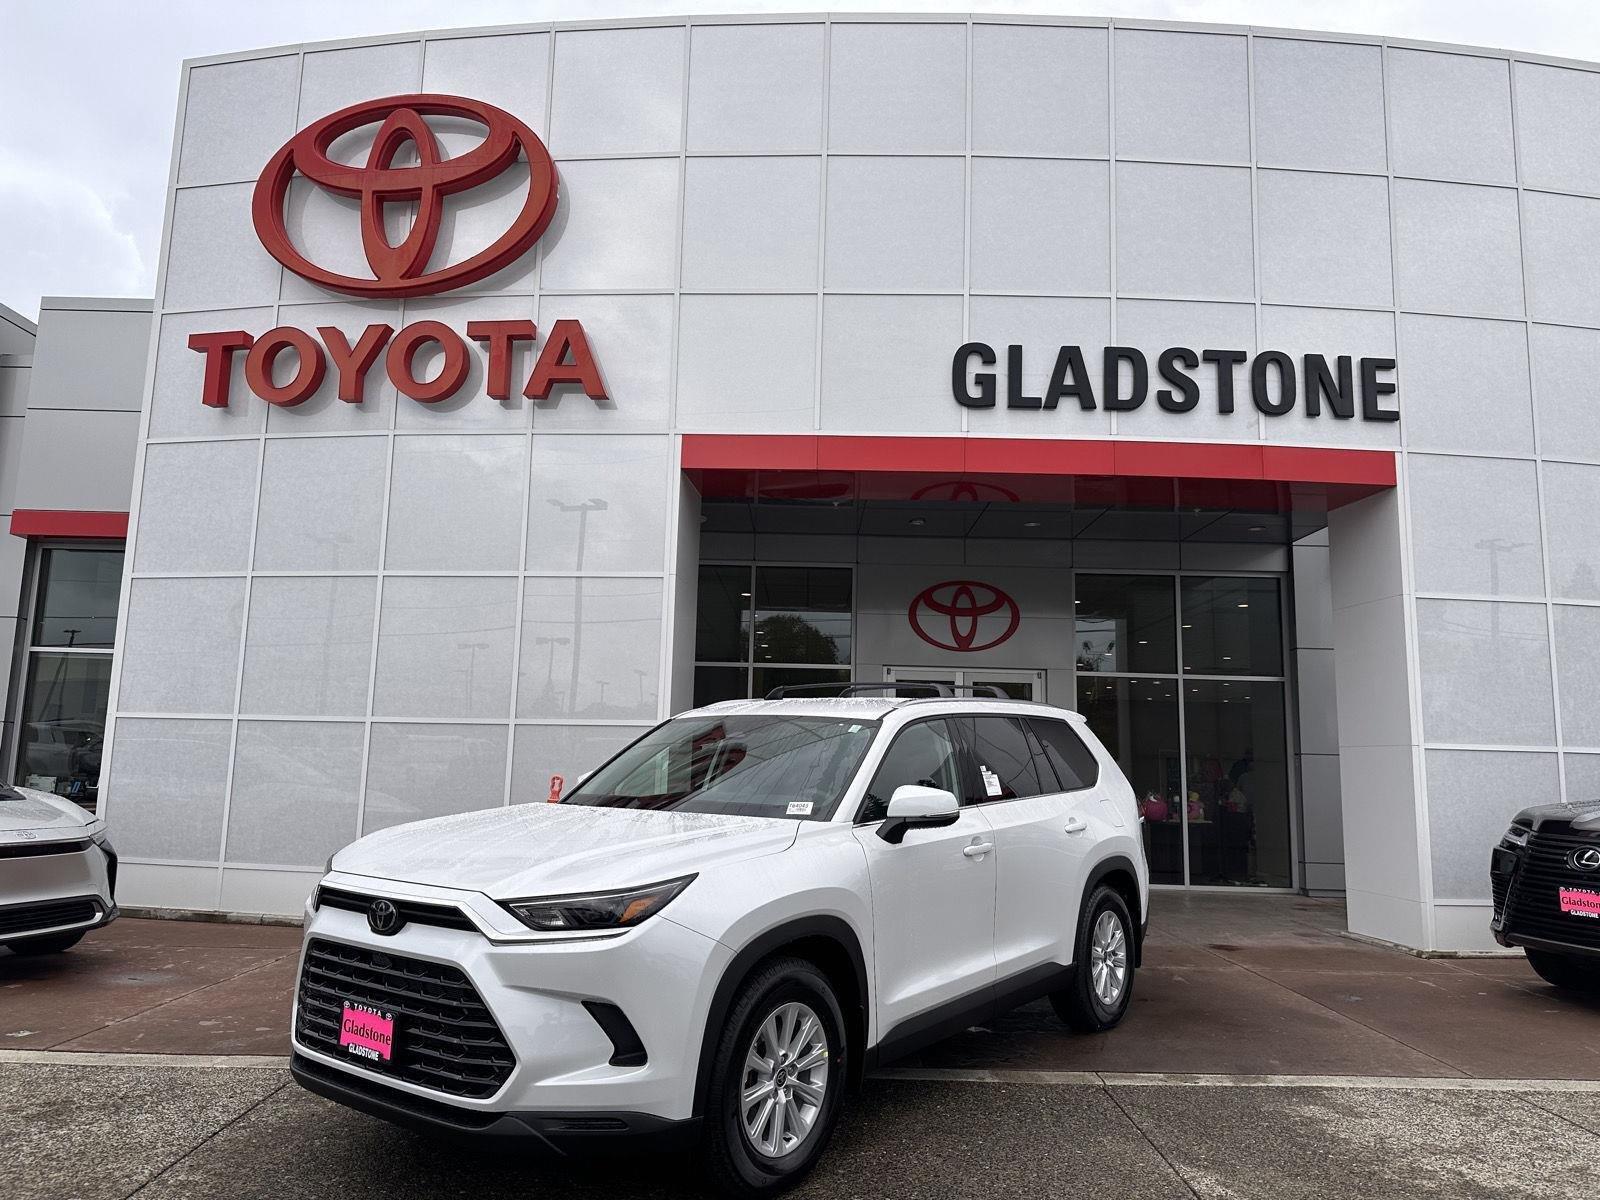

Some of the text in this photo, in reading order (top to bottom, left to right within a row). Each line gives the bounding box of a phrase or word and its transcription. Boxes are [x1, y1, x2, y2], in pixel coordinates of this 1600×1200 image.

[188, 319, 610, 408] TOYOTA
[951, 342, 1400, 421] GLADSTONE
[1569, 887, 1596, 895] TOYOTA
[1561, 896, 1600, 909] Gladston
[1570, 909, 1599, 918] GLADSTONE
[354, 1003, 382, 1017] TOYOTA
[343, 1018, 391, 1046] Gladstone
[348, 1043, 379, 1061] GLADSTONE
